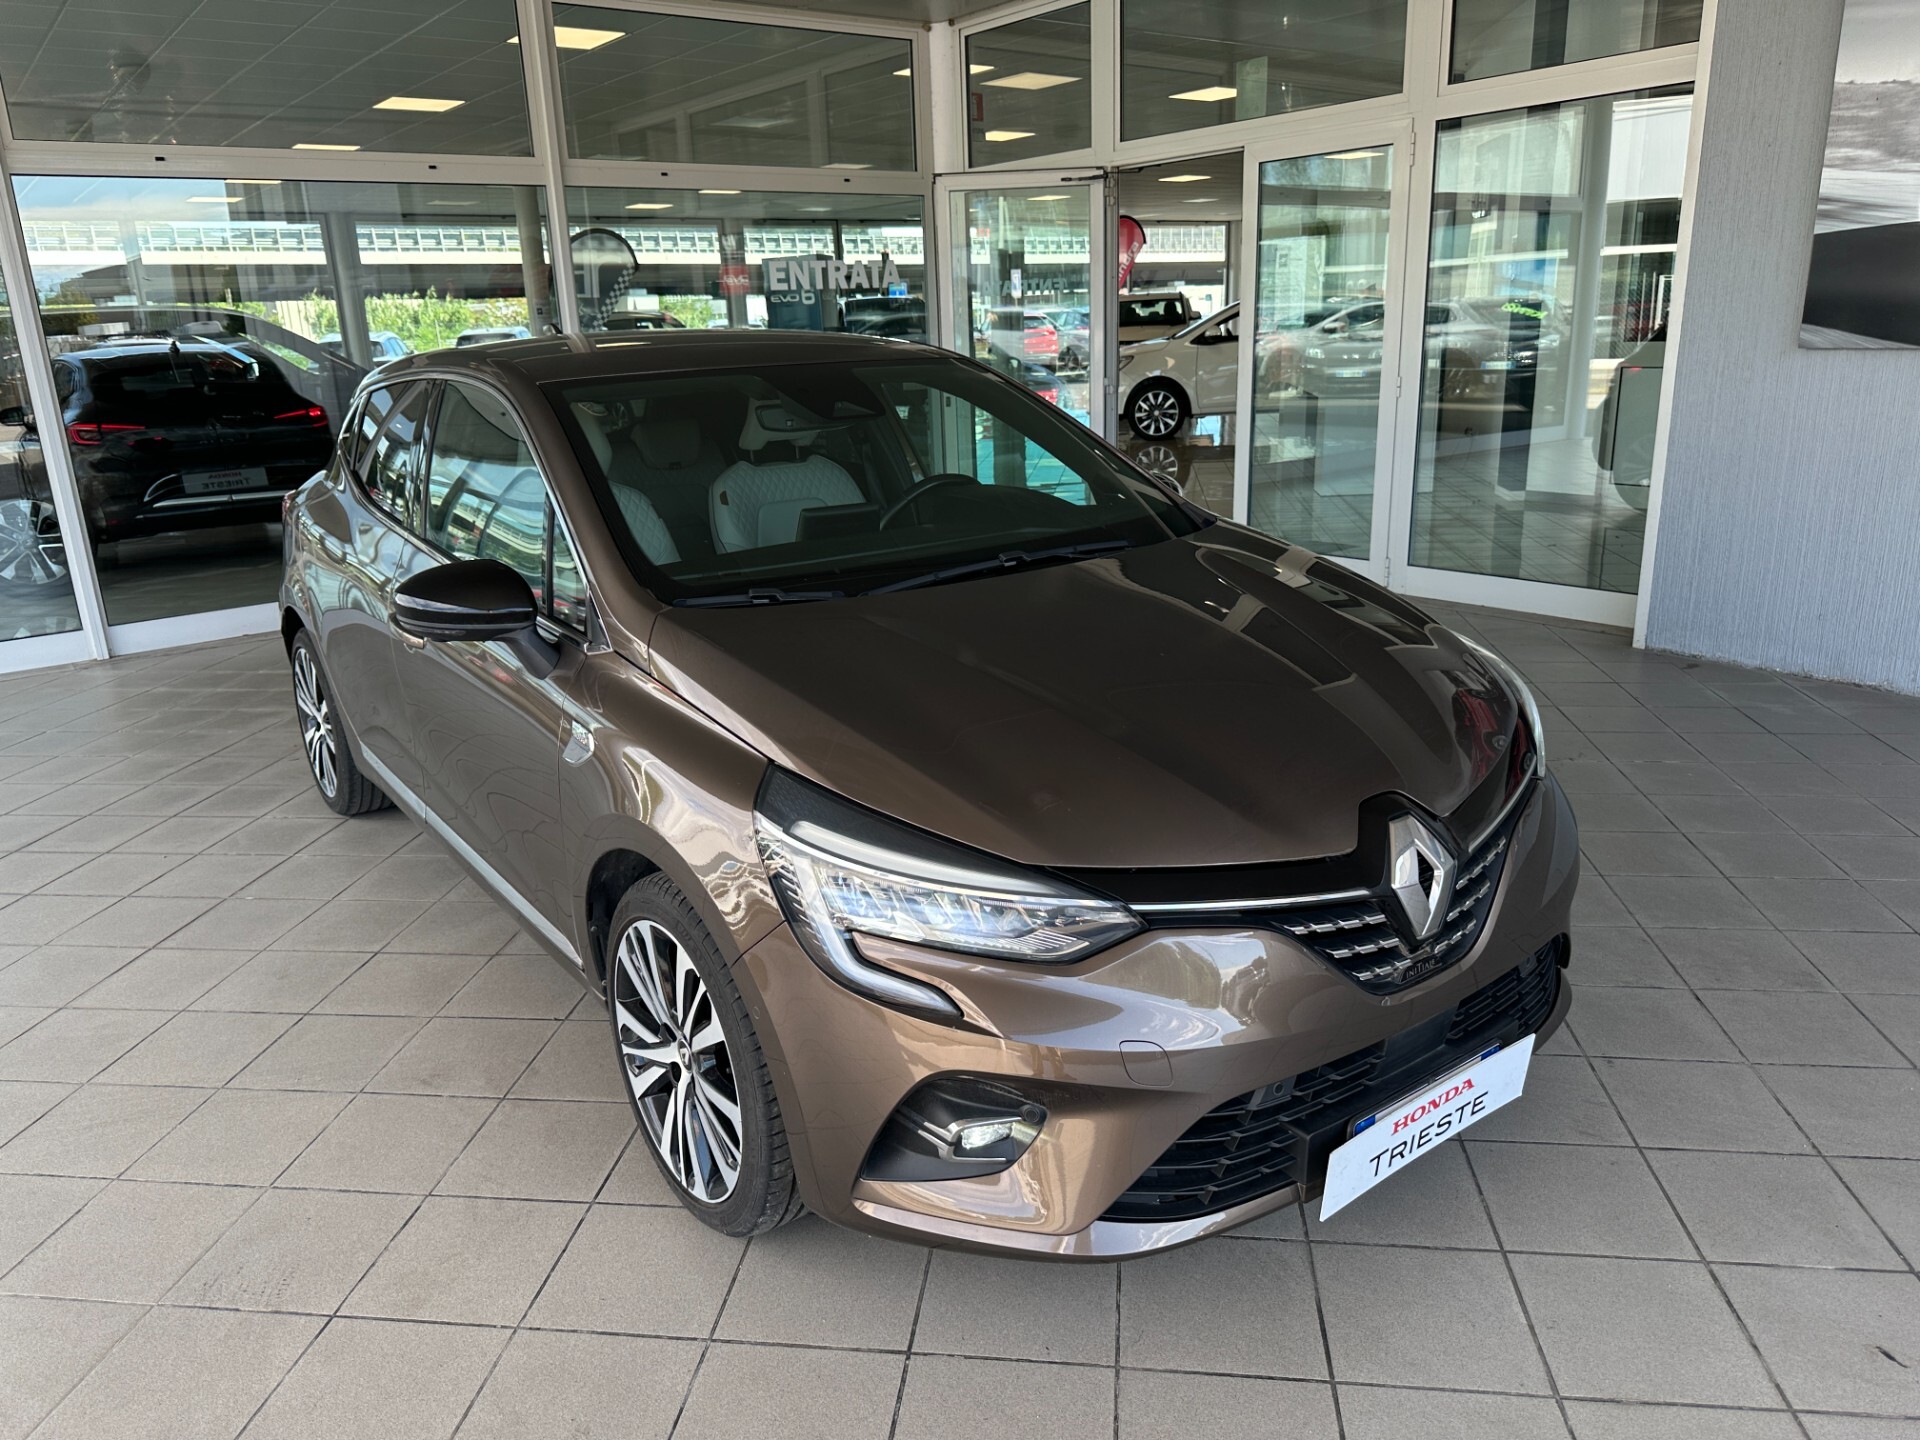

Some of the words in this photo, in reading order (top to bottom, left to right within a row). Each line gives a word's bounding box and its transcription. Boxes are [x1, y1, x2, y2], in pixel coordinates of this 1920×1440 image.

[769, 259, 901, 291] ENTRATA
[1119, 241, 1140, 281] indra
[771, 295, 799, 303] EVO
[801, 289, 815, 304] 6
[1391, 1078, 1475, 1136] HONDA
[1369, 1091, 1489, 1177] TRIESTE
